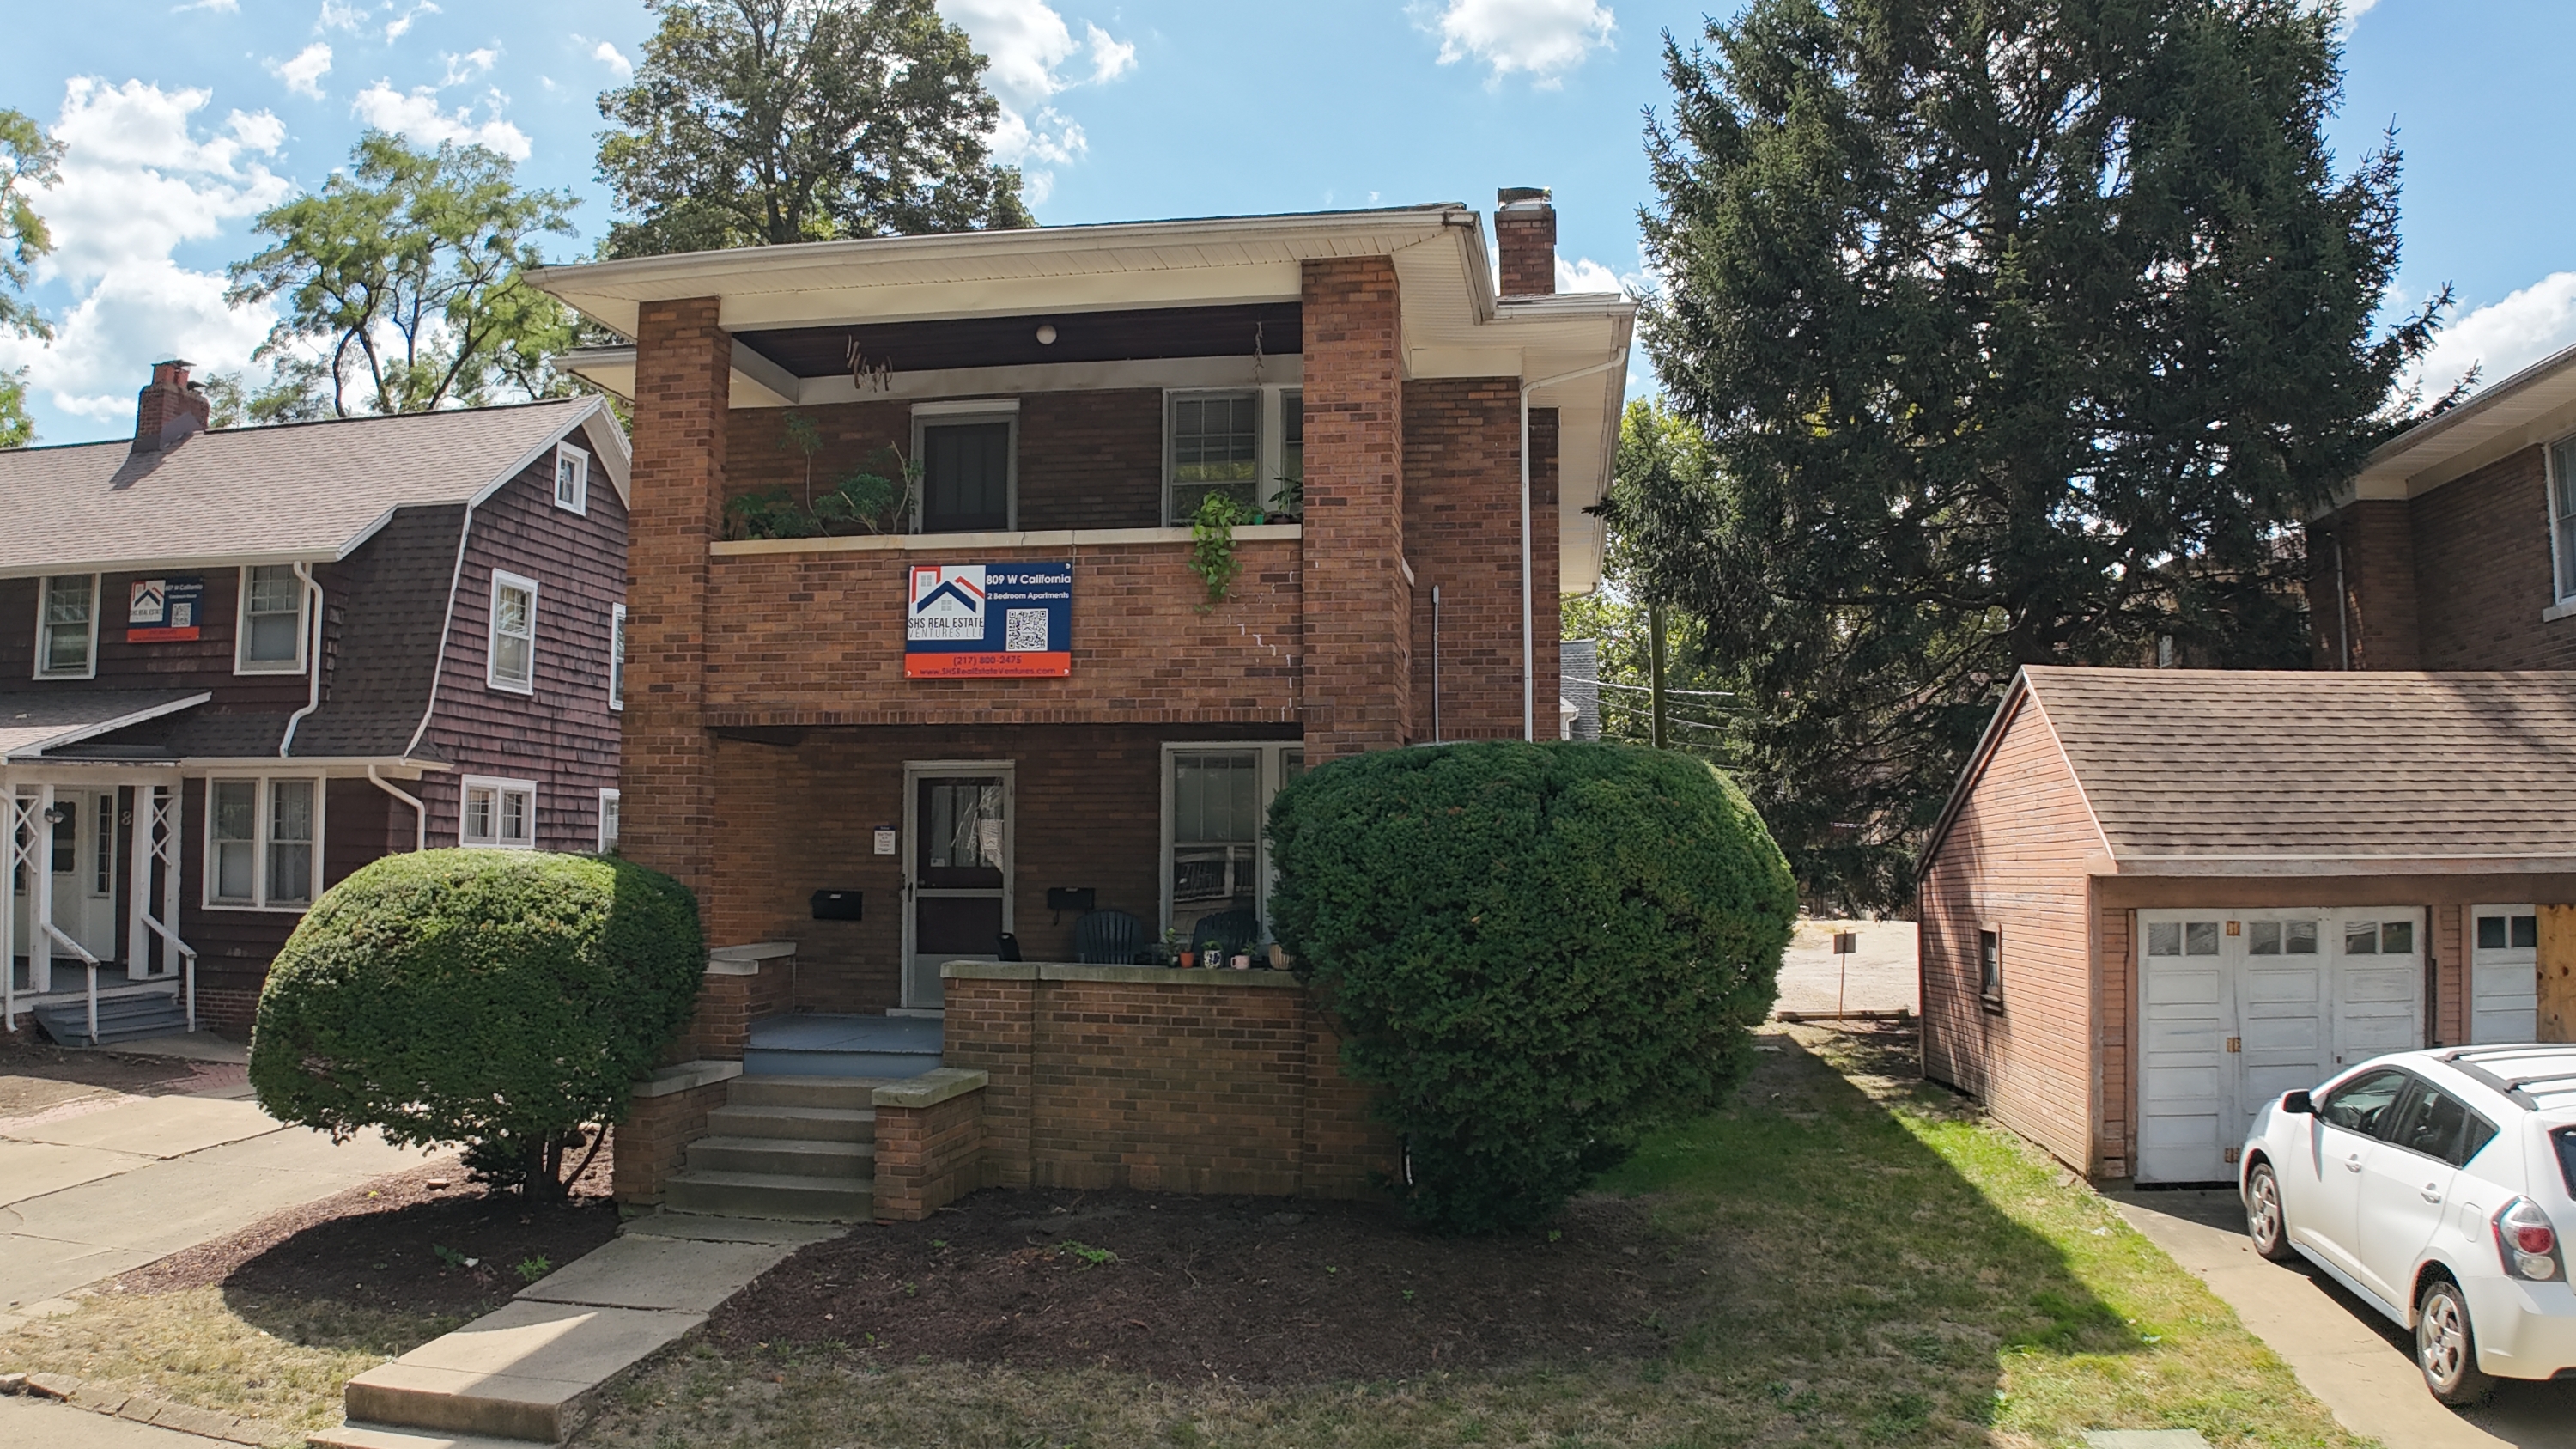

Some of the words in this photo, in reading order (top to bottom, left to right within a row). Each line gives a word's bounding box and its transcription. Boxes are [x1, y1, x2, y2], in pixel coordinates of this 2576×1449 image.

[986, 575, 1005, 585] 809
[1006, 575, 1018, 585] W
[1020, 574, 1071, 584] California
[1027, 592, 1069, 600] Apartments
[908, 618, 925, 628] SHS
[928, 618, 950, 628] REAL
[952, 617, 984, 628] ESTATE
[908, 628, 960, 638] VENTURES
[966, 627, 984, 637] LLC
[953, 656, 976, 666] (217)
[979, 656, 1021, 664] 800-2475
